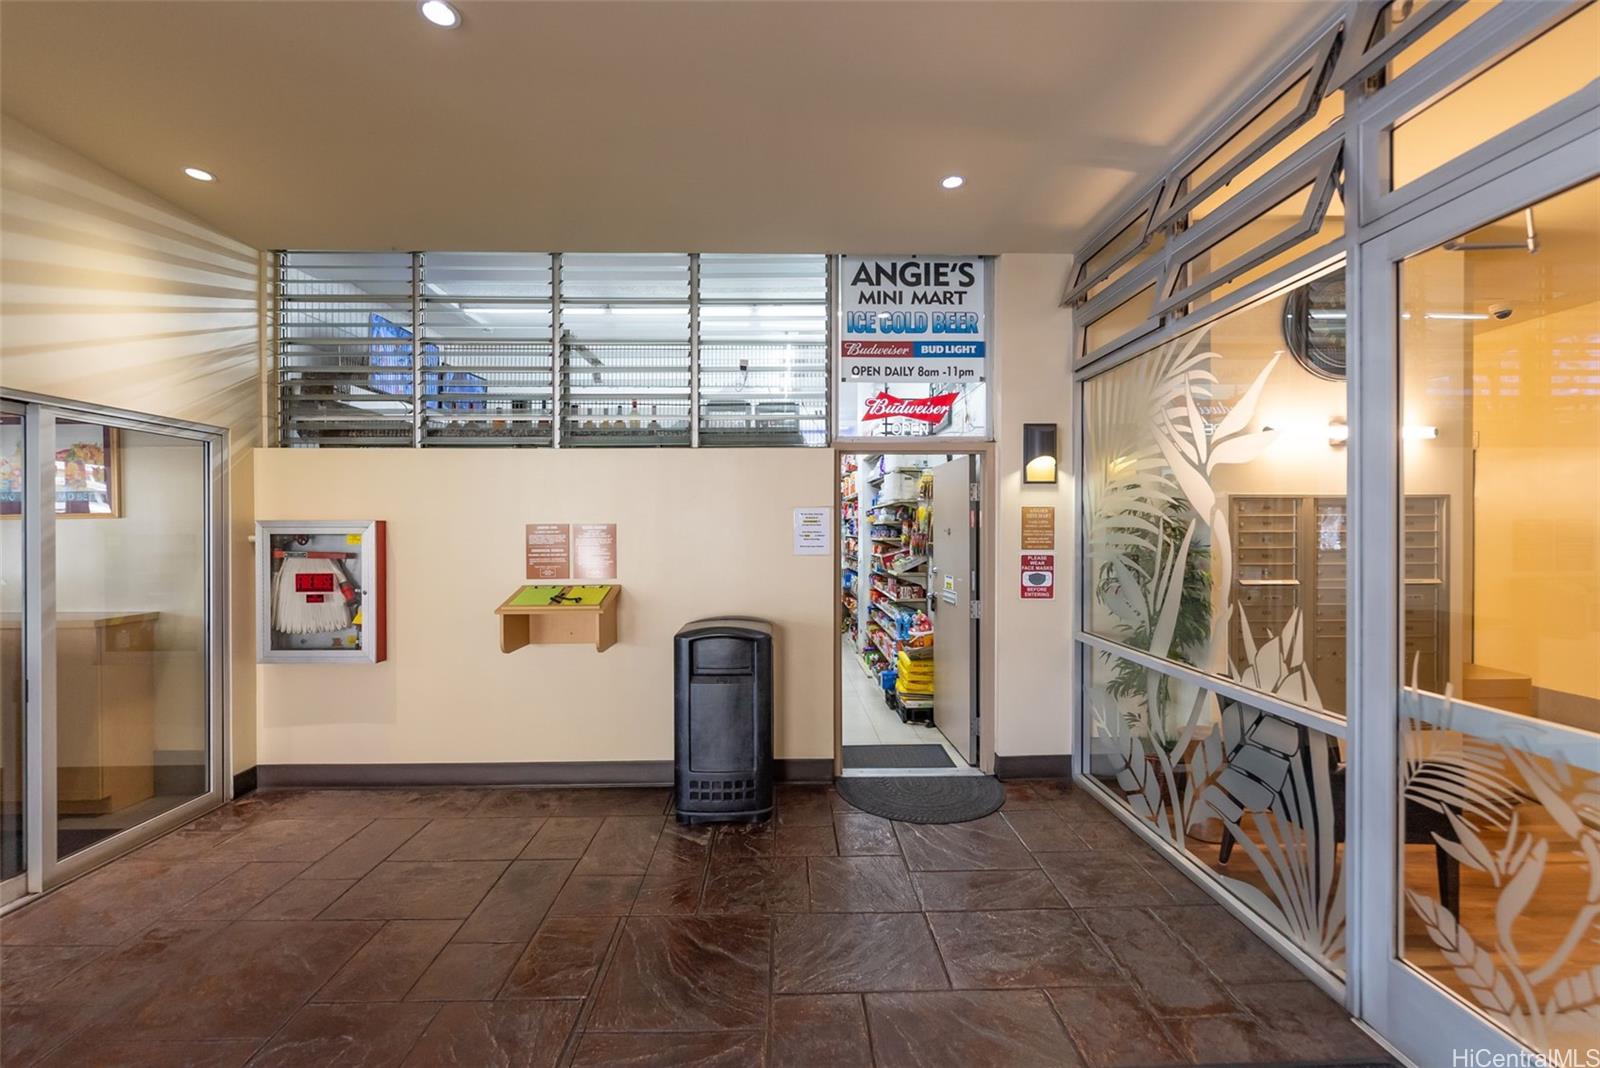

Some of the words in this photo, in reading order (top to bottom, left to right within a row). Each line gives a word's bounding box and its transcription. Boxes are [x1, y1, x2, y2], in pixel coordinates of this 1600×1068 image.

[851, 261, 975, 287] ANGIE'S
[858, 291, 903, 305] MINI
[911, 291, 968, 305] MART
[847, 311, 877, 333] ICE
[879, 311, 929, 334] COLD
[932, 311, 979, 334] BEER
[844, 343, 909, 356] Budweiser
[921, 345, 943, 354] BUD
[945, 345, 977, 354] LIGHT
[851, 366, 881, 377] OPEN
[884, 366, 915, 377] DAILY
[918, 366, 939, 377] 8am
[865, 397, 950, 416] Budweiser
[891, 423, 930, 436] OPEN
